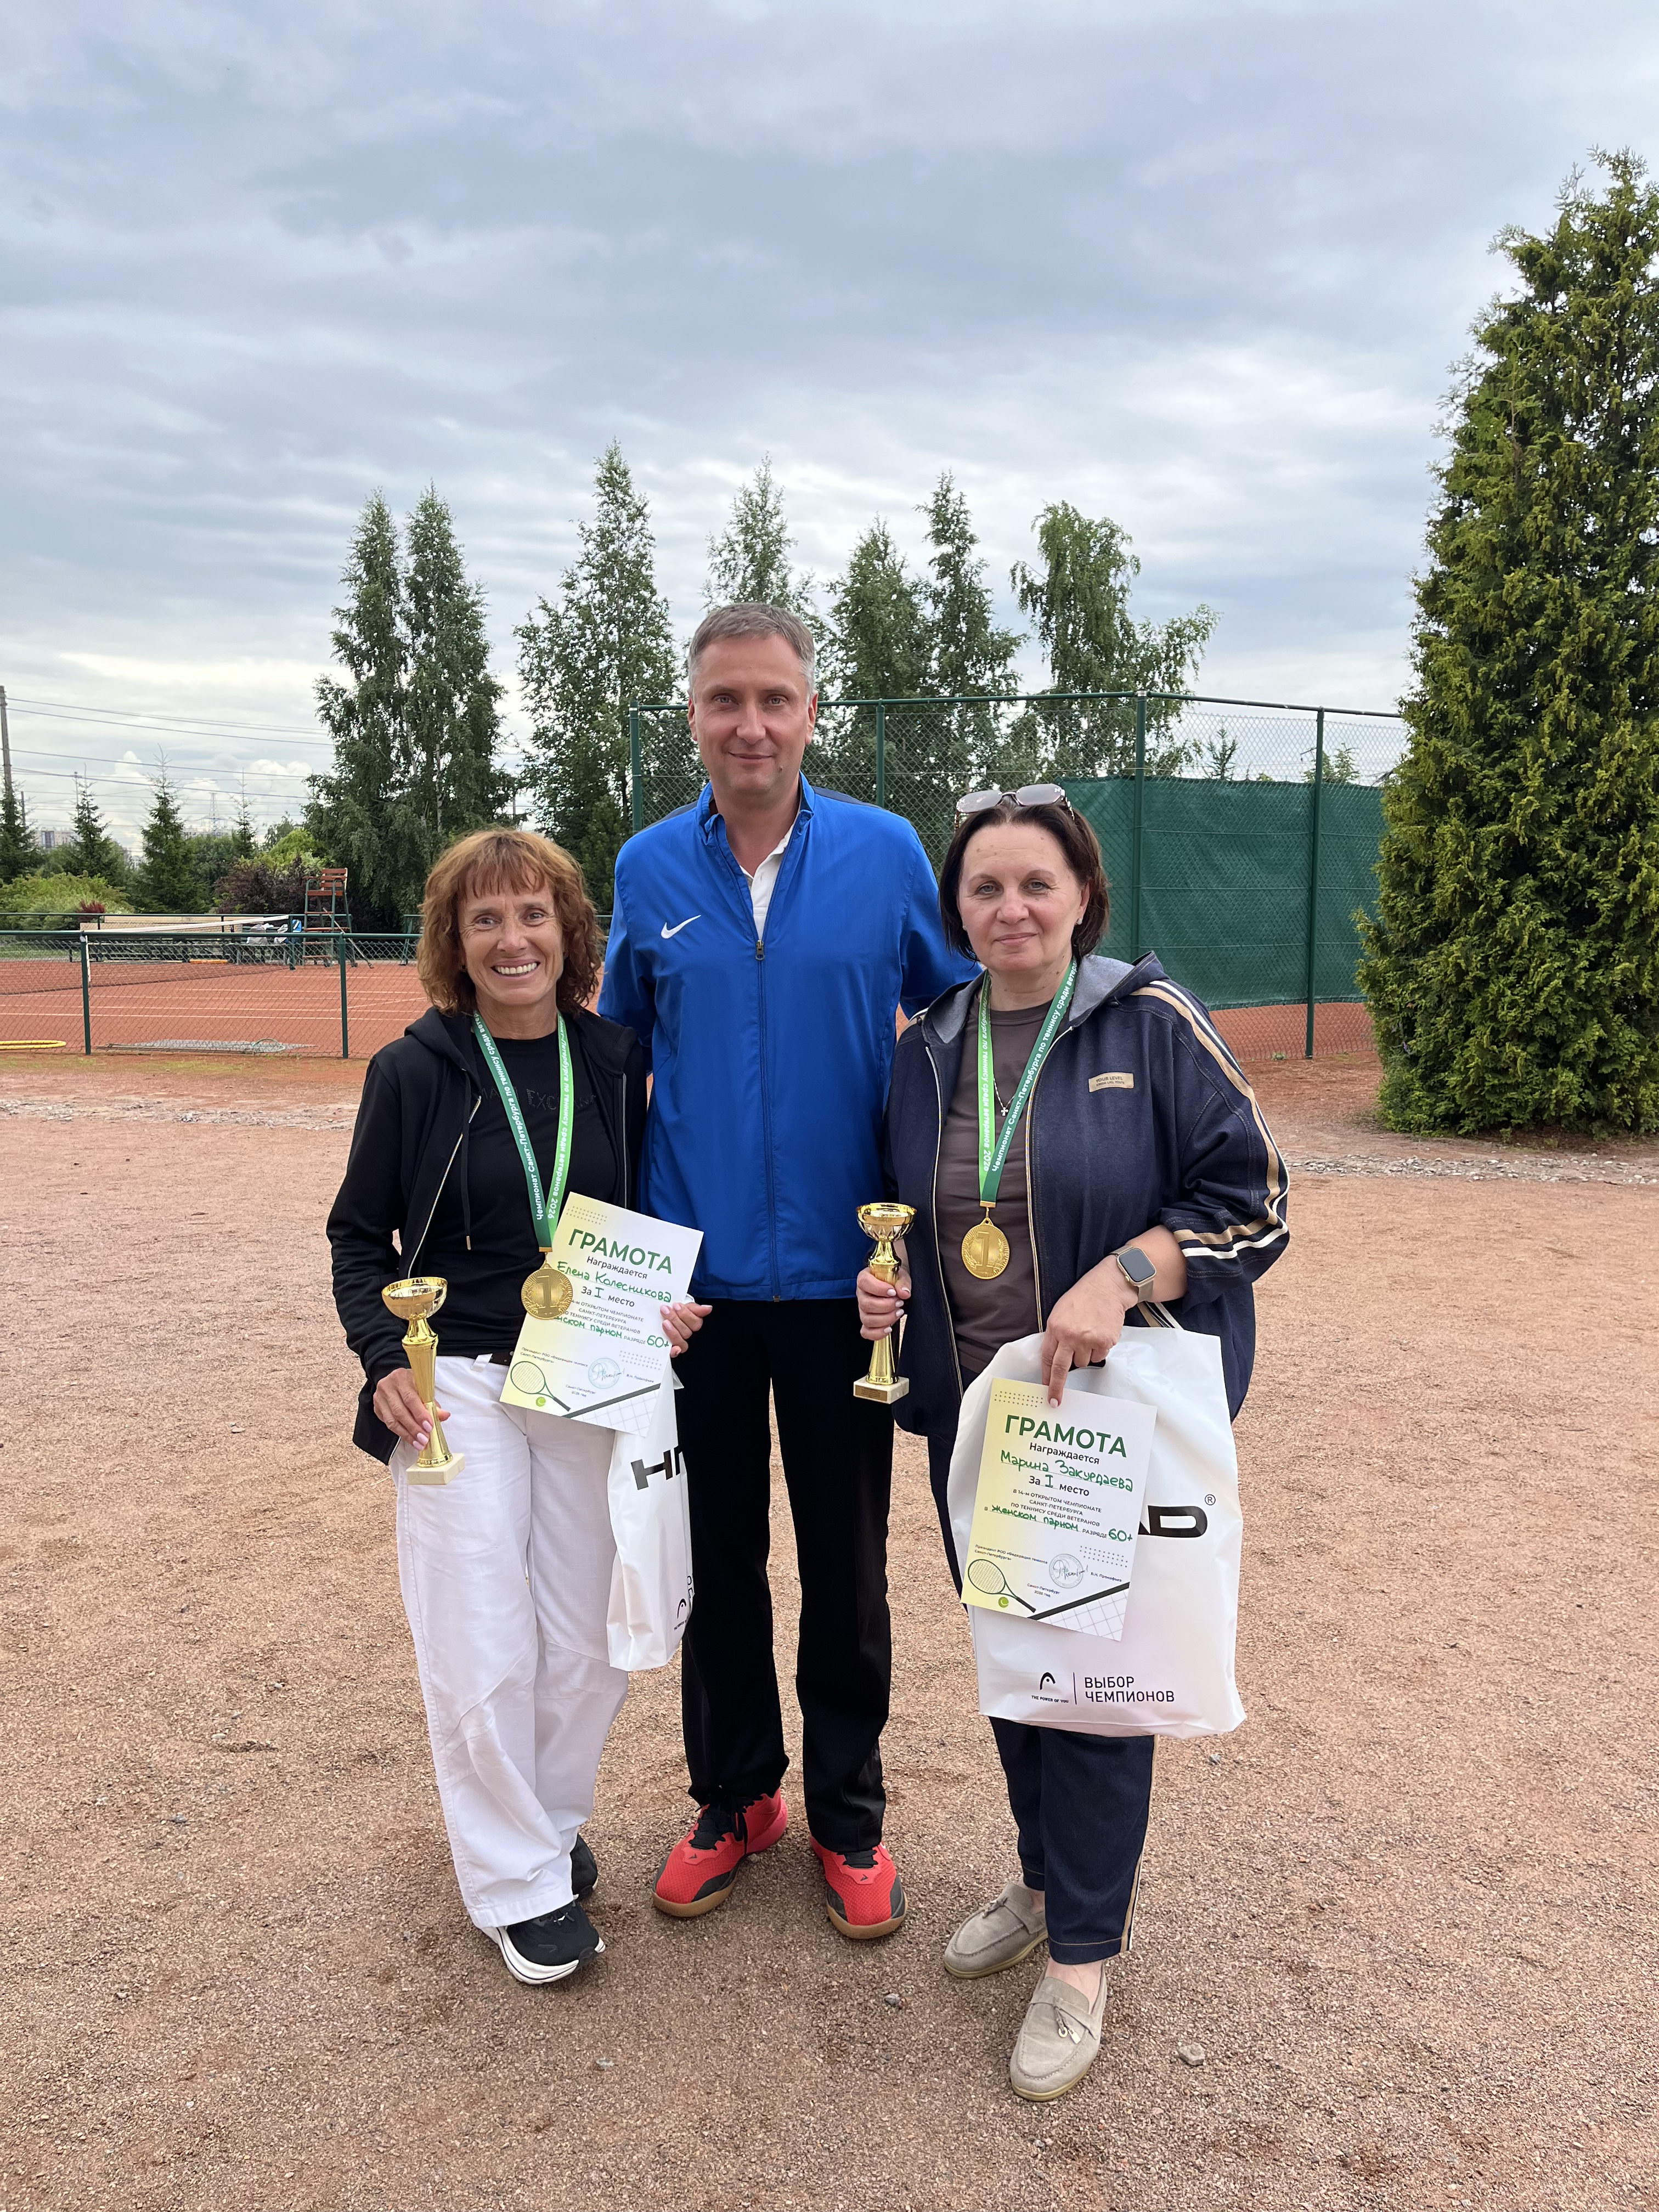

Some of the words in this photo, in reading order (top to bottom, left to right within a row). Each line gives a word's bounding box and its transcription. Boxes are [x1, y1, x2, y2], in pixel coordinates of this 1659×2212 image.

[1058, 986, 1070, 1009] среди
[1042, 1009, 1060, 1041] теннису
[482, 1033, 495, 1055] среди
[983, 1041, 988, 1049] по
[1039, 1042, 1046, 1052] по
[491, 1056, 508, 1085] теннису
[505, 1086, 512, 1096] по
[564, 1082, 569, 1092] по
[1008, 1054, 1042, 1125] Санкт-Петербурга
[508, 1098, 535, 1172] Санкт-Петербурга
[991, 1126, 1012, 1172] Чемпионат
[553, 1154, 565, 1196] ветеранов
[531, 1174, 544, 1220] Чемпионат
[548, 1198, 558, 1218] 2026
[568, 1229, 672, 1274] ГРАМОТА
[586, 1256, 647, 1279] Награждается
[557, 1261, 590, 1280] Елена
[595, 1271, 672, 1303] Колесникова
[581, 1286, 591, 1296] За
[608, 1295, 635, 1307] место
[570, 1312, 593, 1322] ТЕННИСУ
[594, 1318, 611, 1327] СРЕДИ
[611, 1323, 641, 1334] ВЕТЕРАНОВ
[578, 1308, 627, 1324] САНКТ-ПЕТЕРБУРГА
[580, 1302, 609, 1313] ОТКРЫТОМ
[610, 1310, 644, 1322] ЧЕМПИОНАТЕ
[623, 1335, 646, 1345] РАЗРЯДЕ
[647, 1335, 669, 1348] 60+
[1005, 1414, 1127, 1458] ГРАМОТА
[1029, 1442, 1100, 1465] Награждается
[1001, 1449, 1049, 1471] Марина
[1055, 1459, 1133, 1493] Закурдаева
[1029, 1475, 1041, 1486] За
[1059, 1483, 1090, 1497] место
[1029, 1499, 1083, 1516] САНКТ-ПЕТЕРБУРГА
[1030, 1492, 1062, 1504] ОТКРЫТОМ
[1063, 1499, 1102, 1513] ЧЕМПИОНАТЕ
[1020, 1504, 1046, 1515] ТЕННИСУ
[1047, 1510, 1066, 1519] СРЕДИ
[1067, 1515, 1100, 1527] ВЕТЕРАНОВ
[1043, 1516, 1079, 1532] парном
[1082, 1528, 1108, 1539] РАЗРЯДЕ
[1108, 1527, 1133, 1542] 60+
[1084, 1676, 1135, 1689] ВЫБОР
[1085, 1690, 1175, 1703] ЧЕМПИОНОВ
